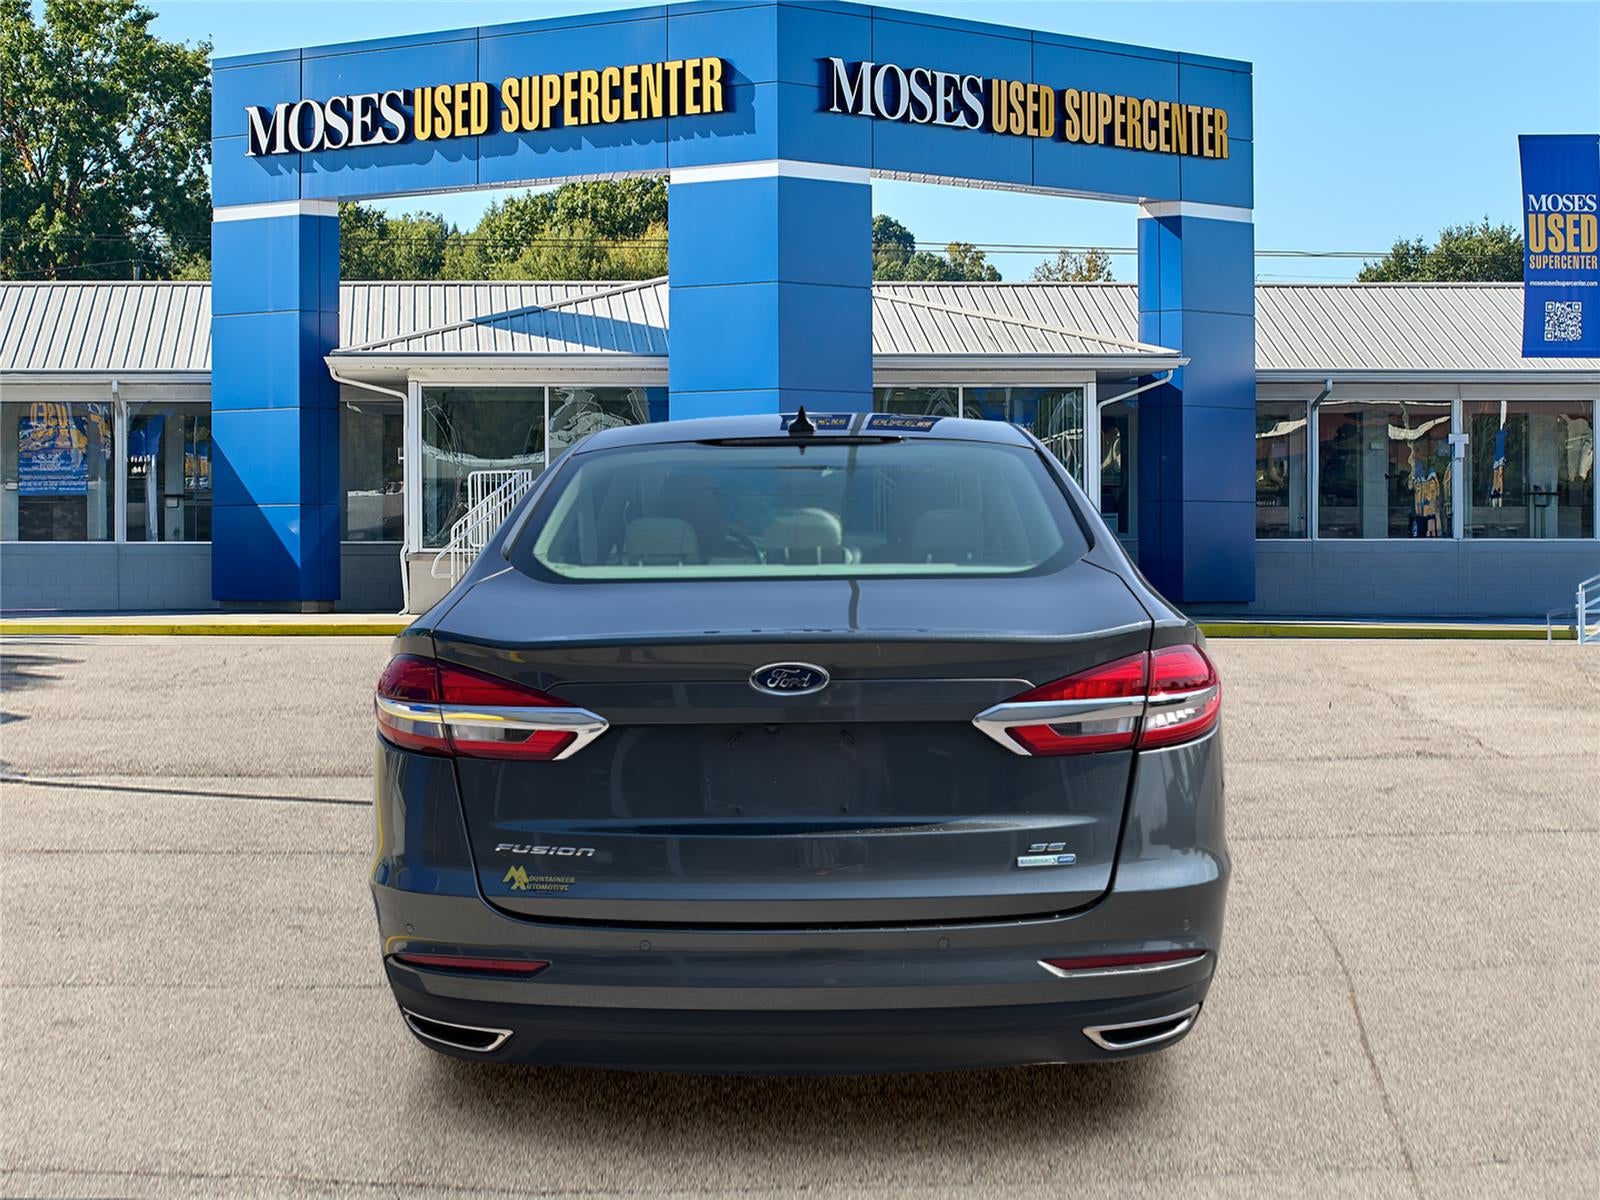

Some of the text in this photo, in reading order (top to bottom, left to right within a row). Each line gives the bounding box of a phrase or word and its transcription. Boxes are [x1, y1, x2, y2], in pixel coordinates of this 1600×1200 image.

[244, 57, 724, 157] MOSES USED SUPERCENTER
[828, 57, 1229, 159] MOSES USED SUPERCENTER
[1528, 193, 1597, 212] MOSES
[1528, 213, 1598, 253] USED
[1529, 255, 1598, 270] SUPERCENTER
[767, 668, 811, 687] Ford
[495, 843, 596, 856] FUSION
